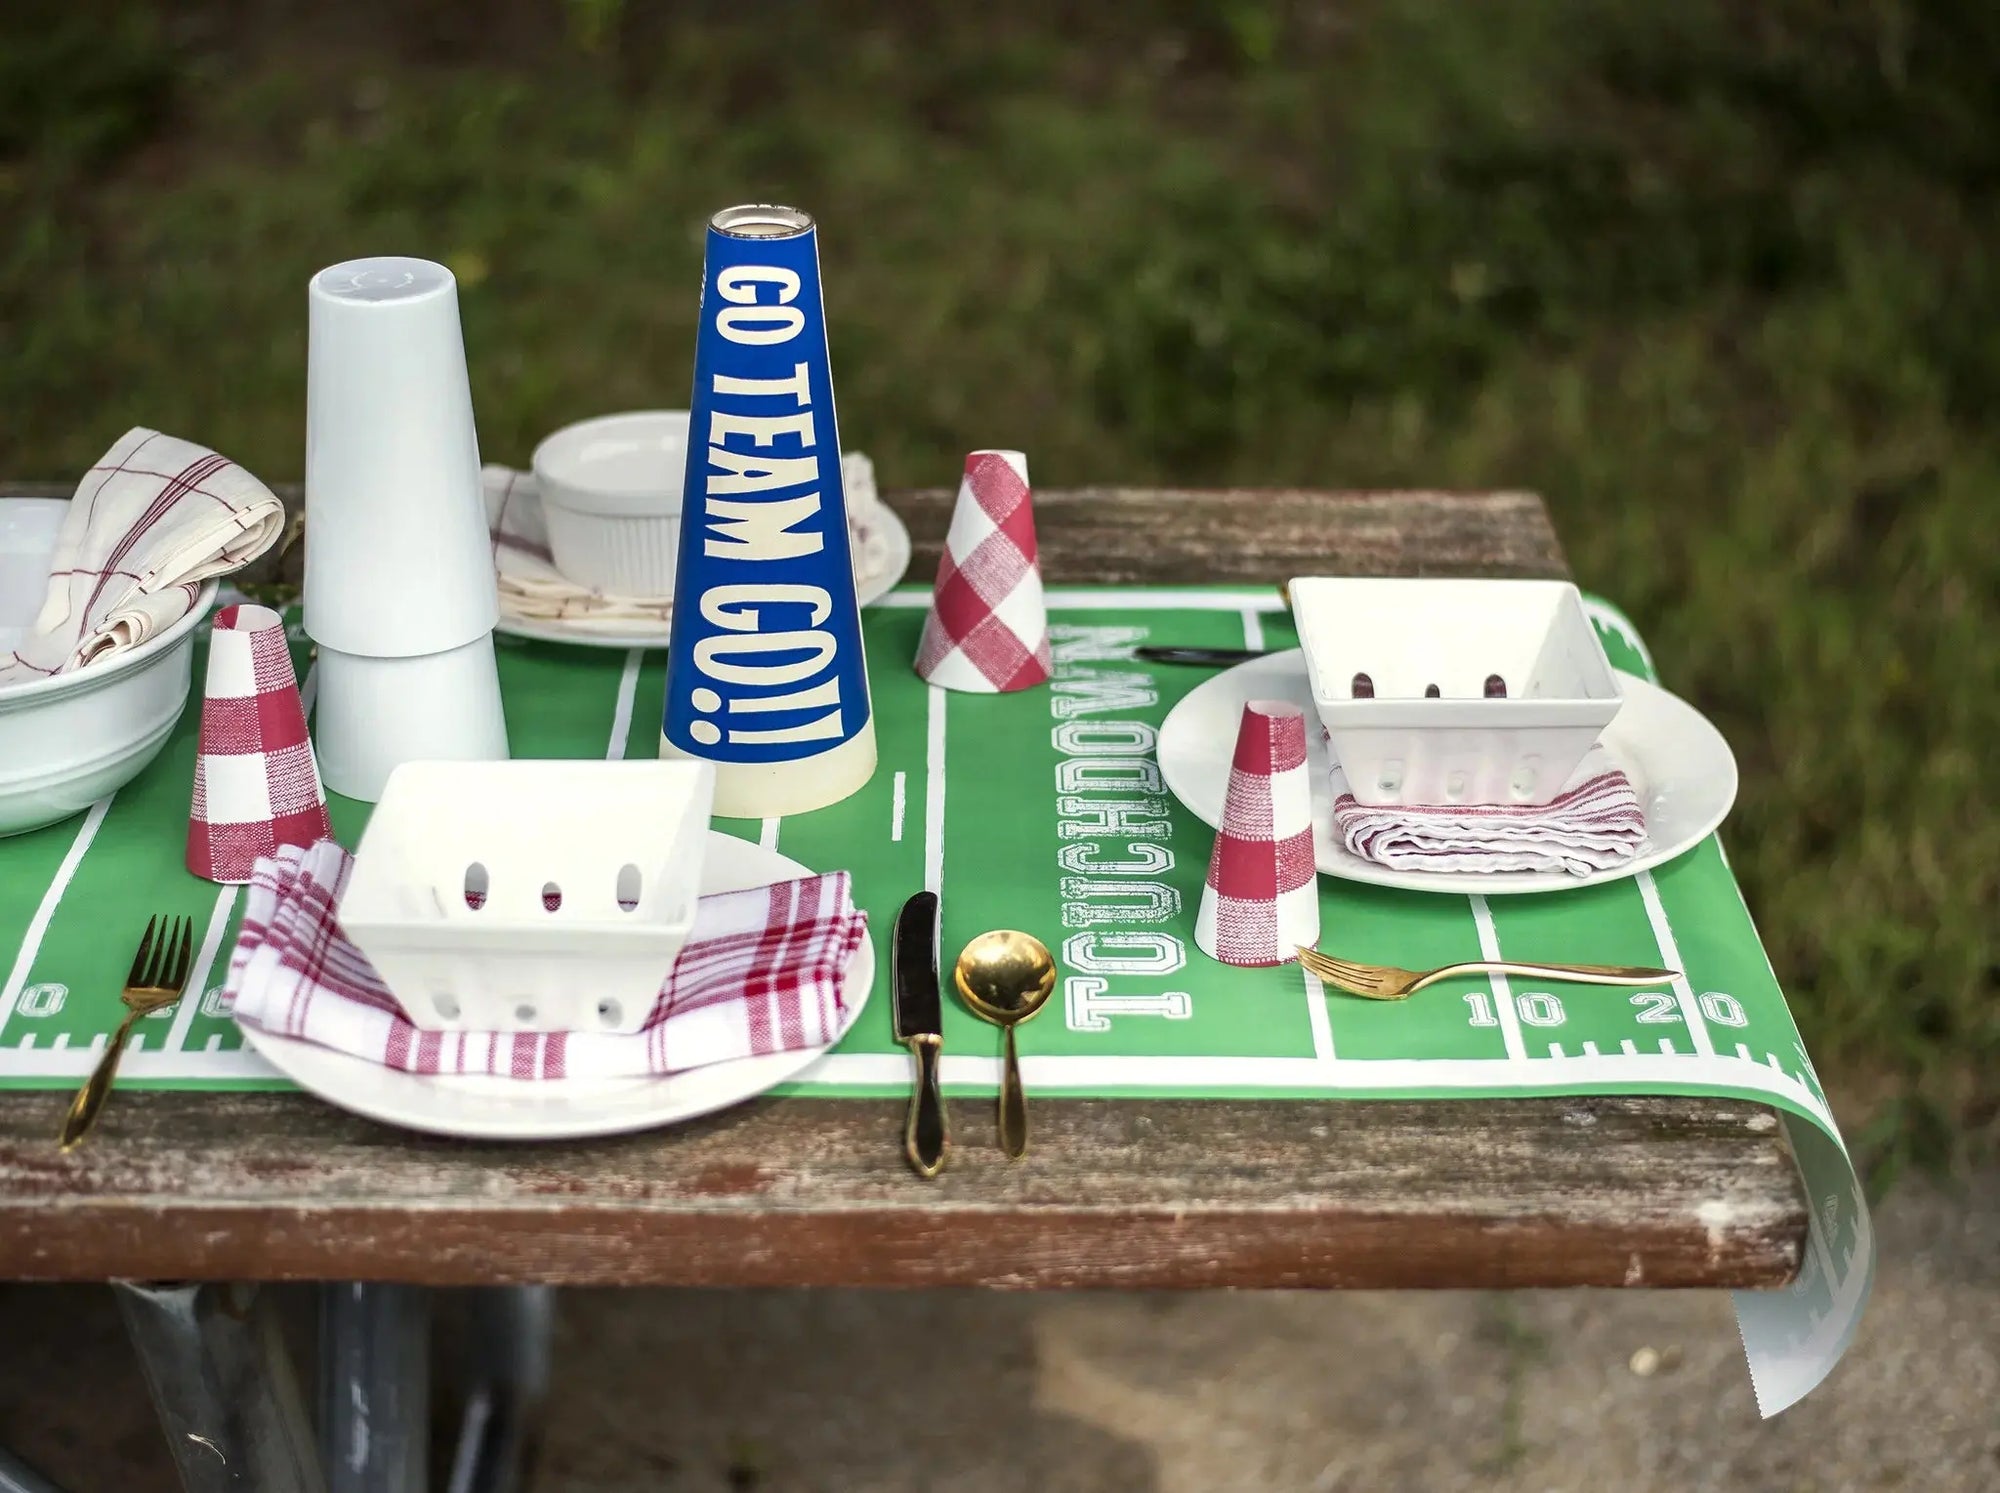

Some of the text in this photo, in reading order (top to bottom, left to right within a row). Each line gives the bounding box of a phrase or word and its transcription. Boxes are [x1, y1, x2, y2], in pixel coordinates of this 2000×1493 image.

[689, 265, 845, 746] GO TEAM GO!!
[1050, 623, 1193, 1033] TOUCHDOWN
